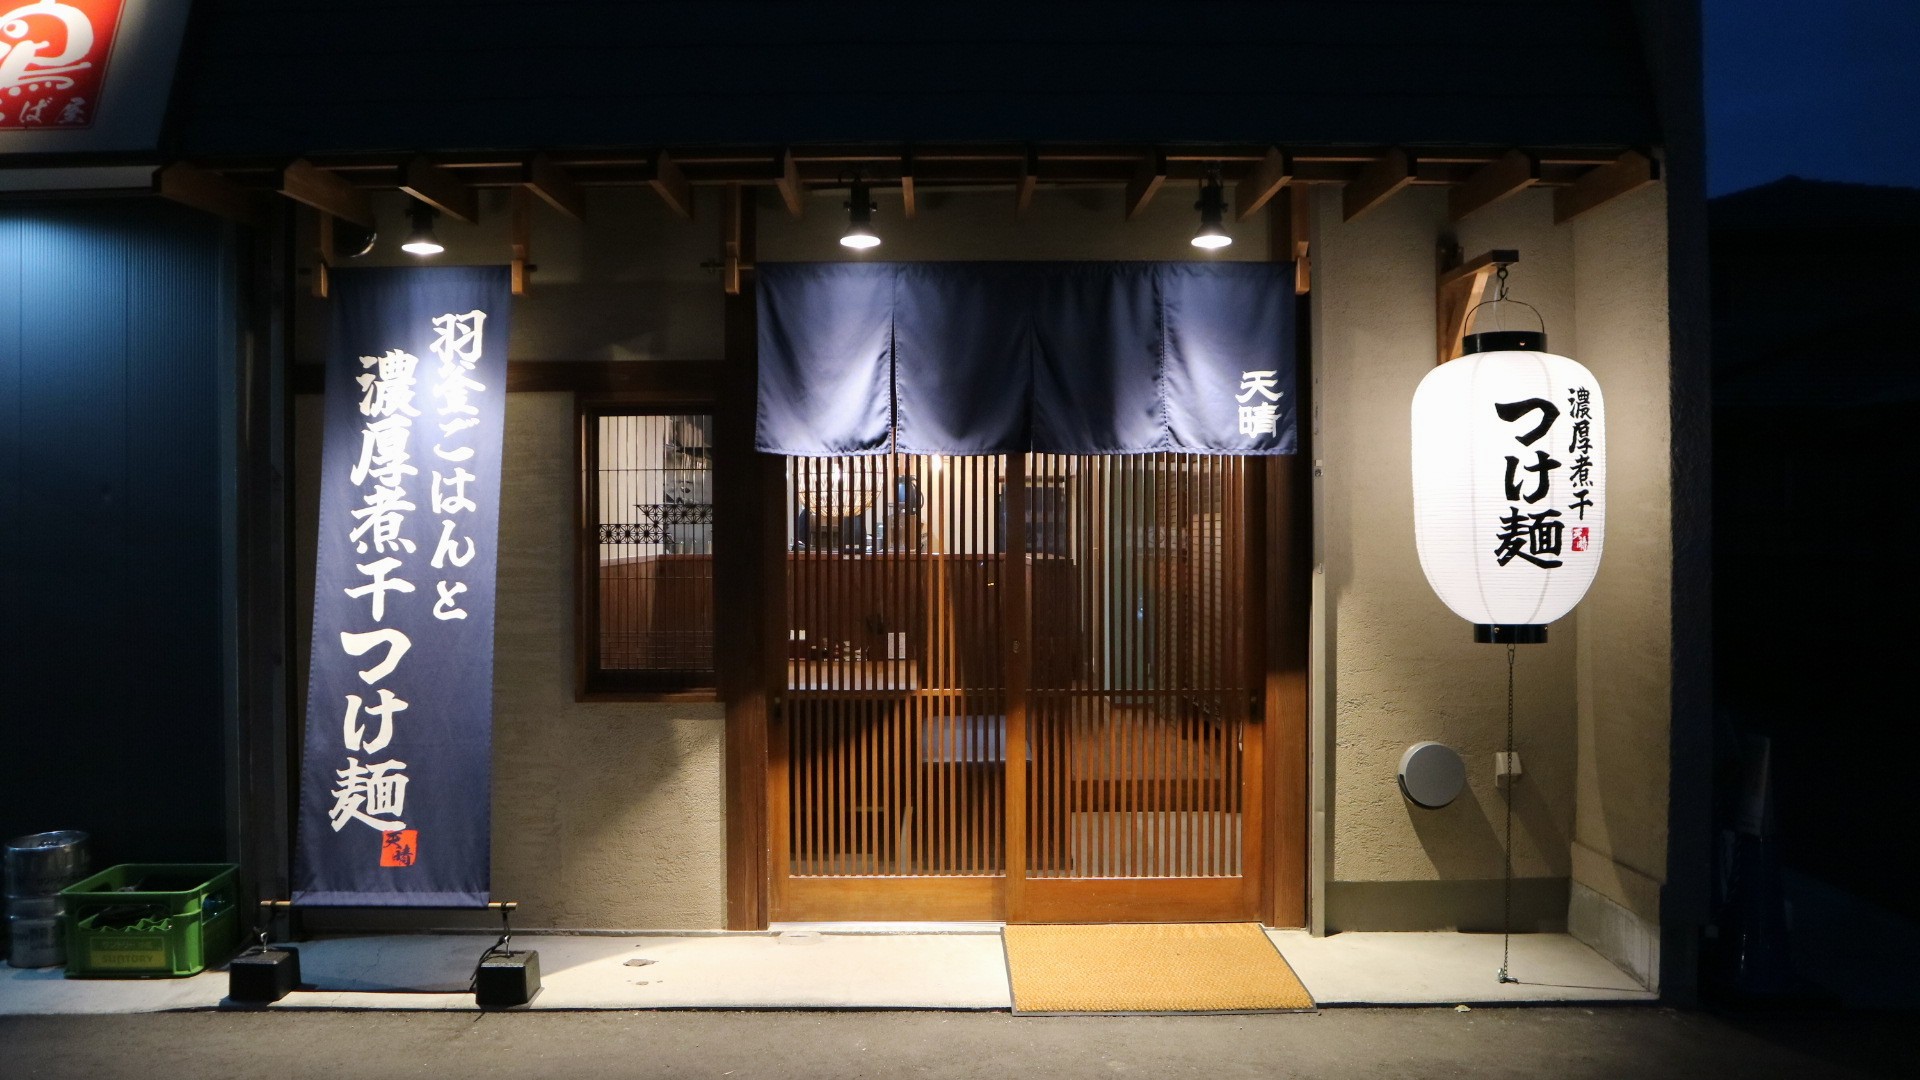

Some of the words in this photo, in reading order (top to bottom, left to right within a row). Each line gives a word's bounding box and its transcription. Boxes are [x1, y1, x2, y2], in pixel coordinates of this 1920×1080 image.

[429, 309, 488, 620] 羽釜ごはんと
[1235, 370, 1284, 438] 天晴
[1494, 397, 1565, 569] つけ麺
[1568, 386, 1594, 521] 濃厚煮干
[328, 348, 422, 832] 濃厚煮干つけ麺
